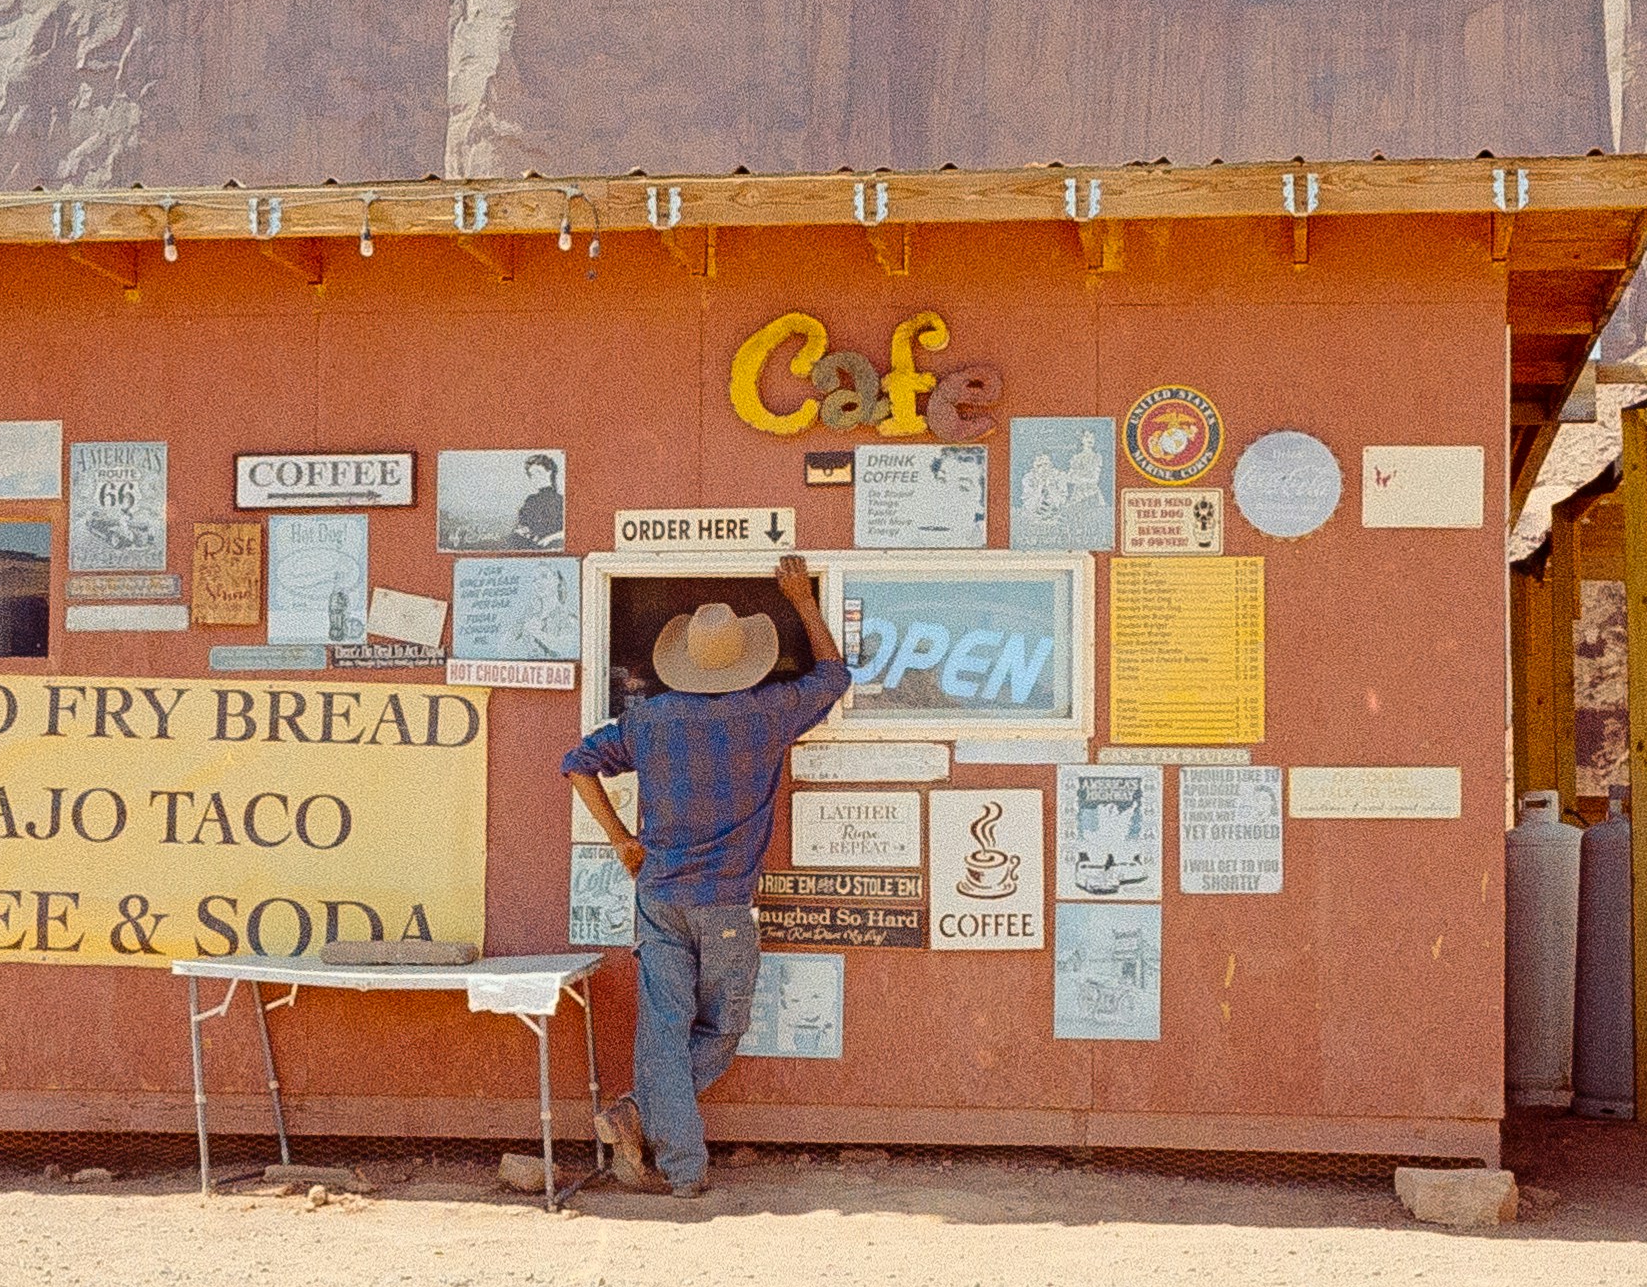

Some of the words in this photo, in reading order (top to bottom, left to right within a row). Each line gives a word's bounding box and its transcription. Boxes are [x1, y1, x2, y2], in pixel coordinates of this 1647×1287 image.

[729, 311, 1003, 444] Cafe
[1130, 389, 1172, 425] UNITED
[1178, 389, 1215, 426] STATES
[867, 454, 916, 467] DRINK
[1132, 452, 1173, 481] MARINE
[1180, 451, 1214, 479] CORPS
[248, 460, 402, 487] COFFEE
[863, 471, 919, 483] COFFEE
[99, 483, 135, 508] 66
[1160, 509, 1184, 519] DOG
[290, 523, 316, 543] Hot
[622, 521, 690, 541] ORDER
[698, 519, 750, 540] HERE
[848, 616, 1054, 703] OPEN
[450, 663, 473, 681] HOT
[476, 664, 543, 684] CHOCOLATE
[546, 667, 571, 685] BAR
[44, 686, 194, 740] FRY
[208, 688, 481, 749] BREAD
[150, 790, 353, 850] TACO
[820, 805, 898, 820] LATHER
[1183, 824, 1208, 840] YET
[1211, 824, 1280, 840] OFFENDED
[830, 841, 889, 855] REPEAT
[1190, 859, 1215, 873] WILL
[1218, 859, 1238, 873] GET
[1258, 859, 1280, 873] YOU
[765, 875, 795, 894] RIDE
[853, 876, 893, 896] STOLE
[1202, 875, 1261, 891] SHORTLY
[110, 893, 170, 955] &
[192, 893, 436, 959] SODA
[760, 907, 830, 927] aughed
[836, 909, 861, 925] So
[867, 911, 919, 928] Hard
[940, 912, 1034, 939] COFFEE
